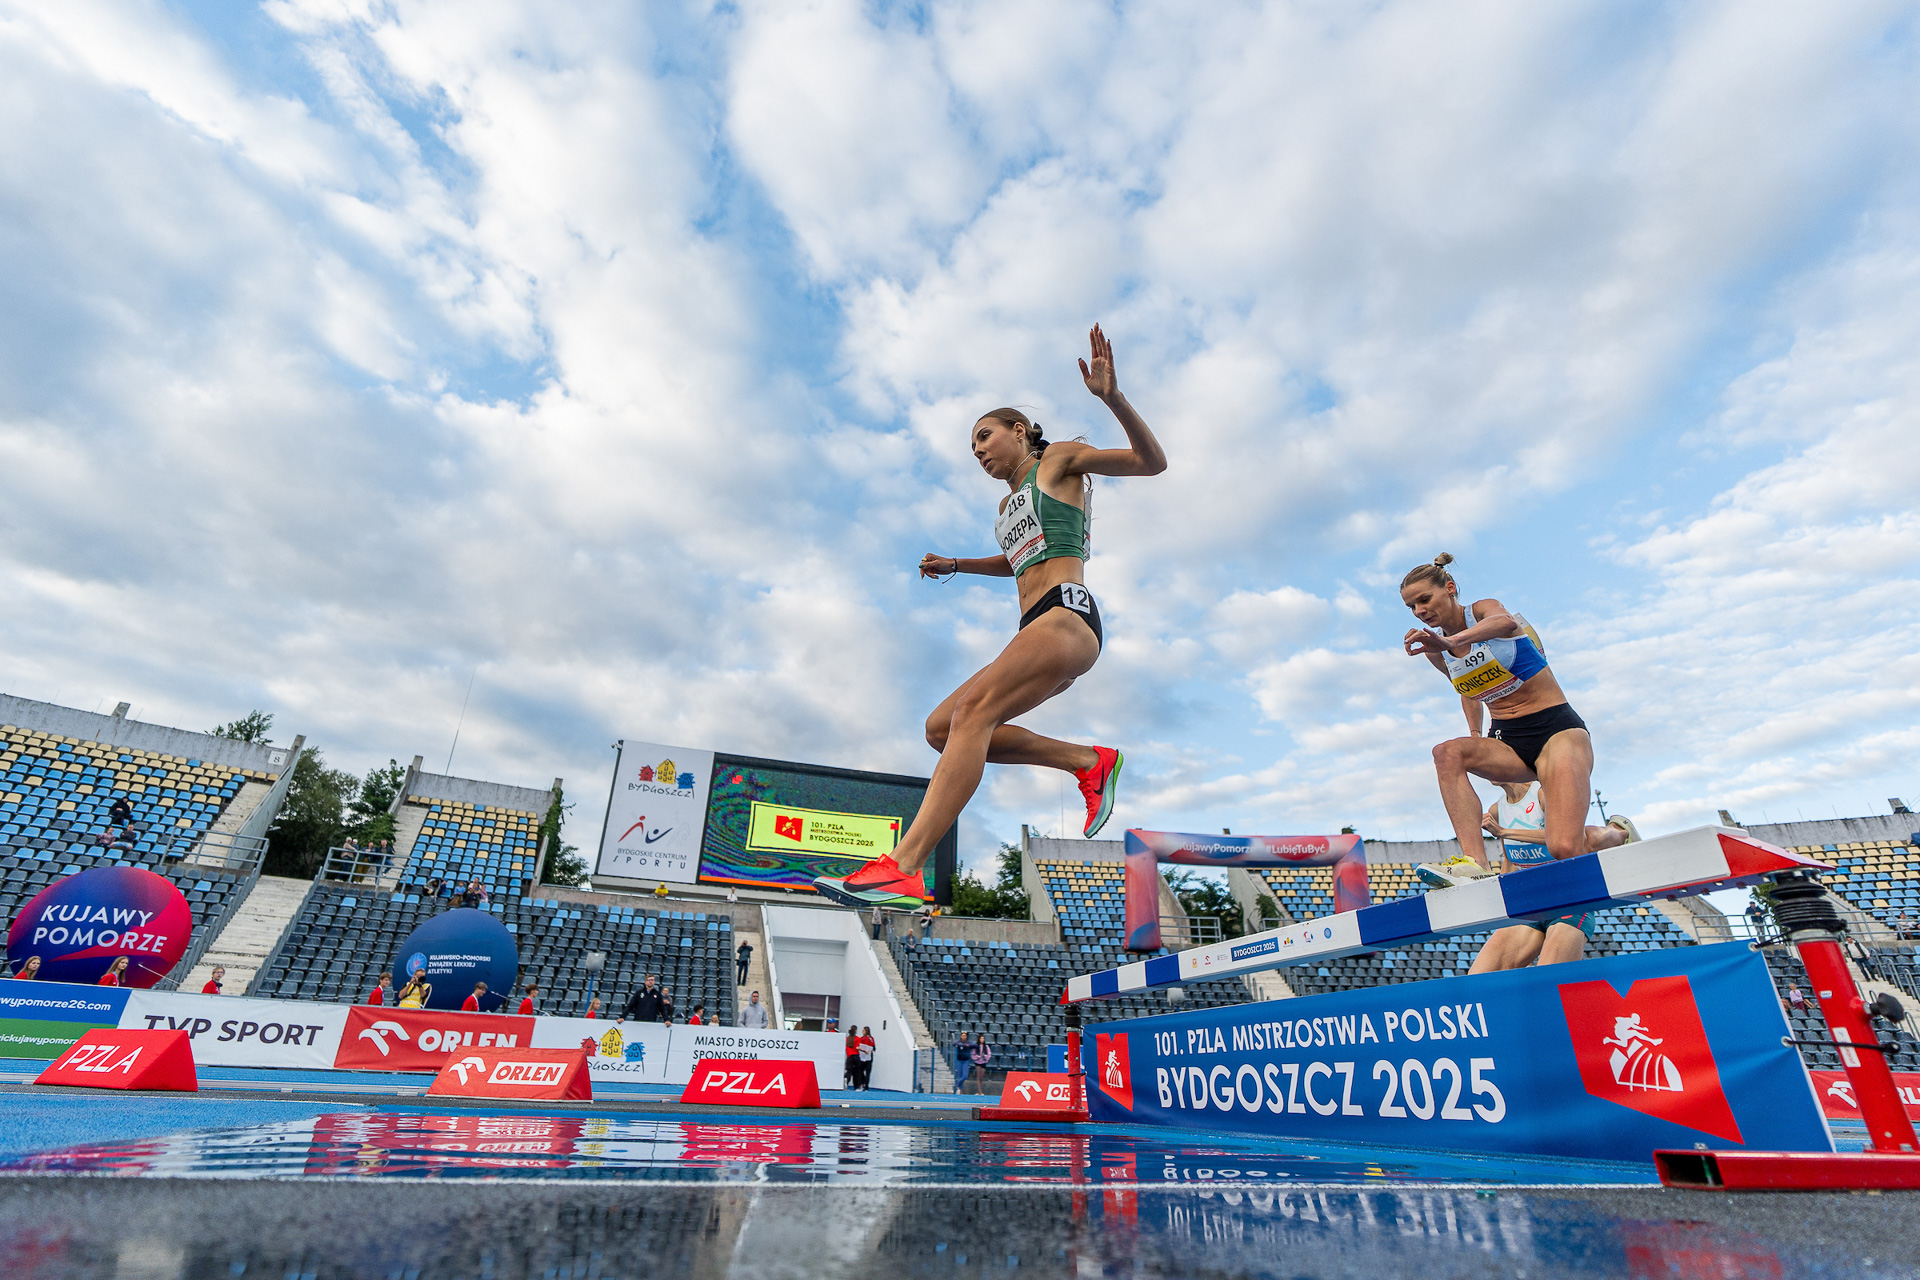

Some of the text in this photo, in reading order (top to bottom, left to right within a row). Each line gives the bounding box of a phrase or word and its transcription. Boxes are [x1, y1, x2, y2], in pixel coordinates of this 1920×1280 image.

[1008, 494, 1026, 518] 218
[1064, 587, 1089, 608] 12
[1464, 651, 1485, 668] 499
[1455, 665, 1506, 694] KONIECZEK
[628, 782, 693, 799] BYDGOSZCZ
[811, 821, 844, 831] 101. PZLA
[809, 834, 874, 847] BYDGOSZCZ 2025
[617, 847, 687, 861] BYDGOSKIE CENTRUM
[1509, 847, 1547, 860] KRÓLIK
[40, 904, 154, 928] KUJAWY
[33, 926, 168, 953] POMORZE
[429, 954, 491, 962] KUJAWSKO-POMORSKI
[1233, 945, 1262, 958] BYDGOSZCZ
[1263, 941, 1276, 952] 2025
[0, 997, 111, 1011] wypomorze26.com
[144, 1014, 324, 1046] TVP SPORT
[1154, 1002, 1489, 1057] 101. PZLA MISTRZOSTWA POLSKI
[694, 1036, 799, 1050] MIASTO BYDGOSZCZ
[58, 1045, 143, 1074] PZLA
[692, 1050, 758, 1060] SPONSOREM
[495, 1065, 560, 1082] ORLEN
[701, 1071, 786, 1095] PZLA
[1156, 1057, 1507, 1124] BYDGOSZCZ 2025
